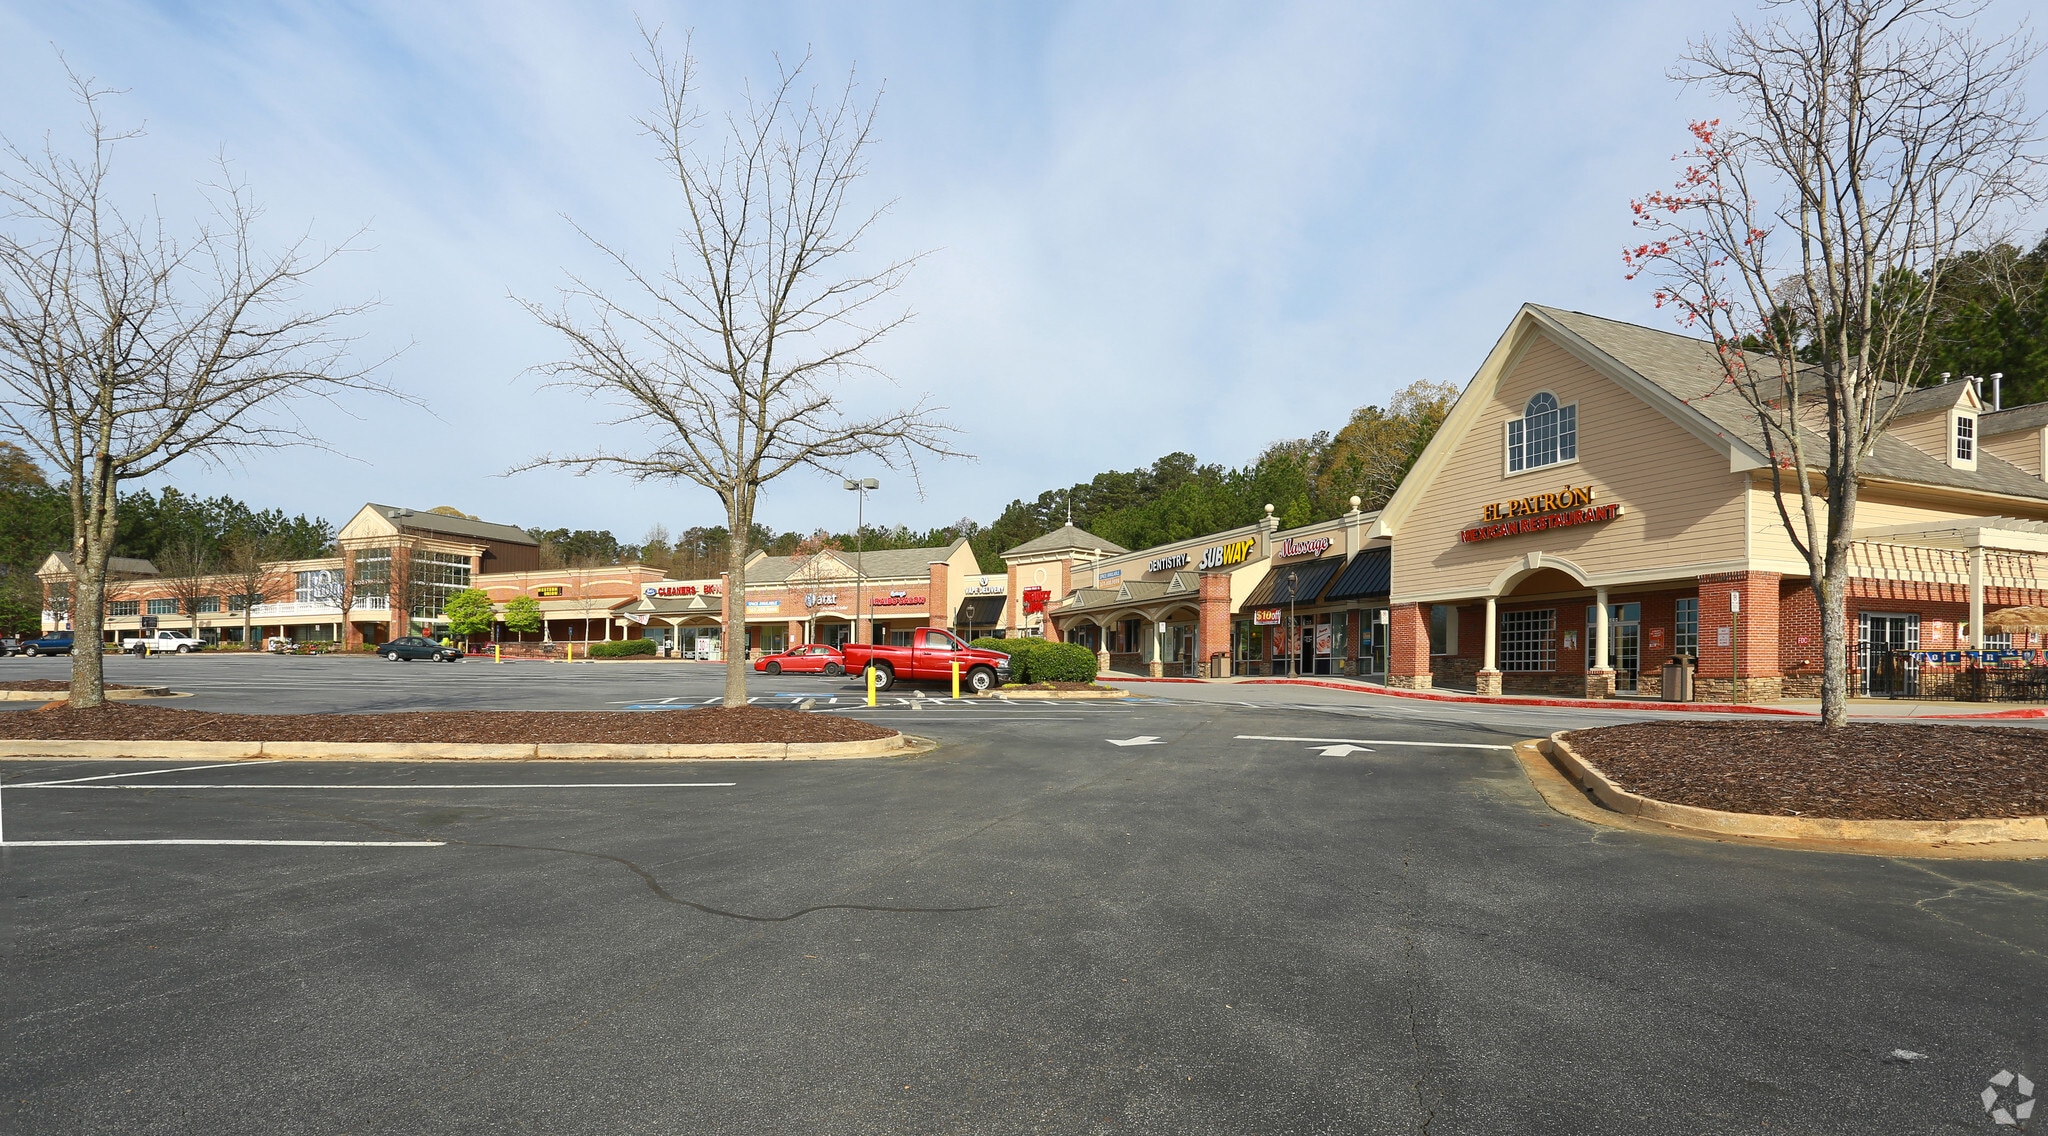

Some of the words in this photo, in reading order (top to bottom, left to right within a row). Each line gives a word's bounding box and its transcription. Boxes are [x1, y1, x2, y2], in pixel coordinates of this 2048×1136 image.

[1482, 503, 1503, 522] EL
[1507, 485, 1593, 518] PATRÓN
[1461, 521, 1520, 543] MEXICAN
[1520, 504, 1619, 534] RESTAURANT
[1199, 537, 1256, 570] SUBWAY
[1278, 537, 1329, 558] Massage
[1148, 553, 1187, 572] DENTISTRY
[658, 586, 696, 596] CLEANERS
[965, 587, 979, 595] VAPE
[979, 586, 1004, 595] DELIVERY
